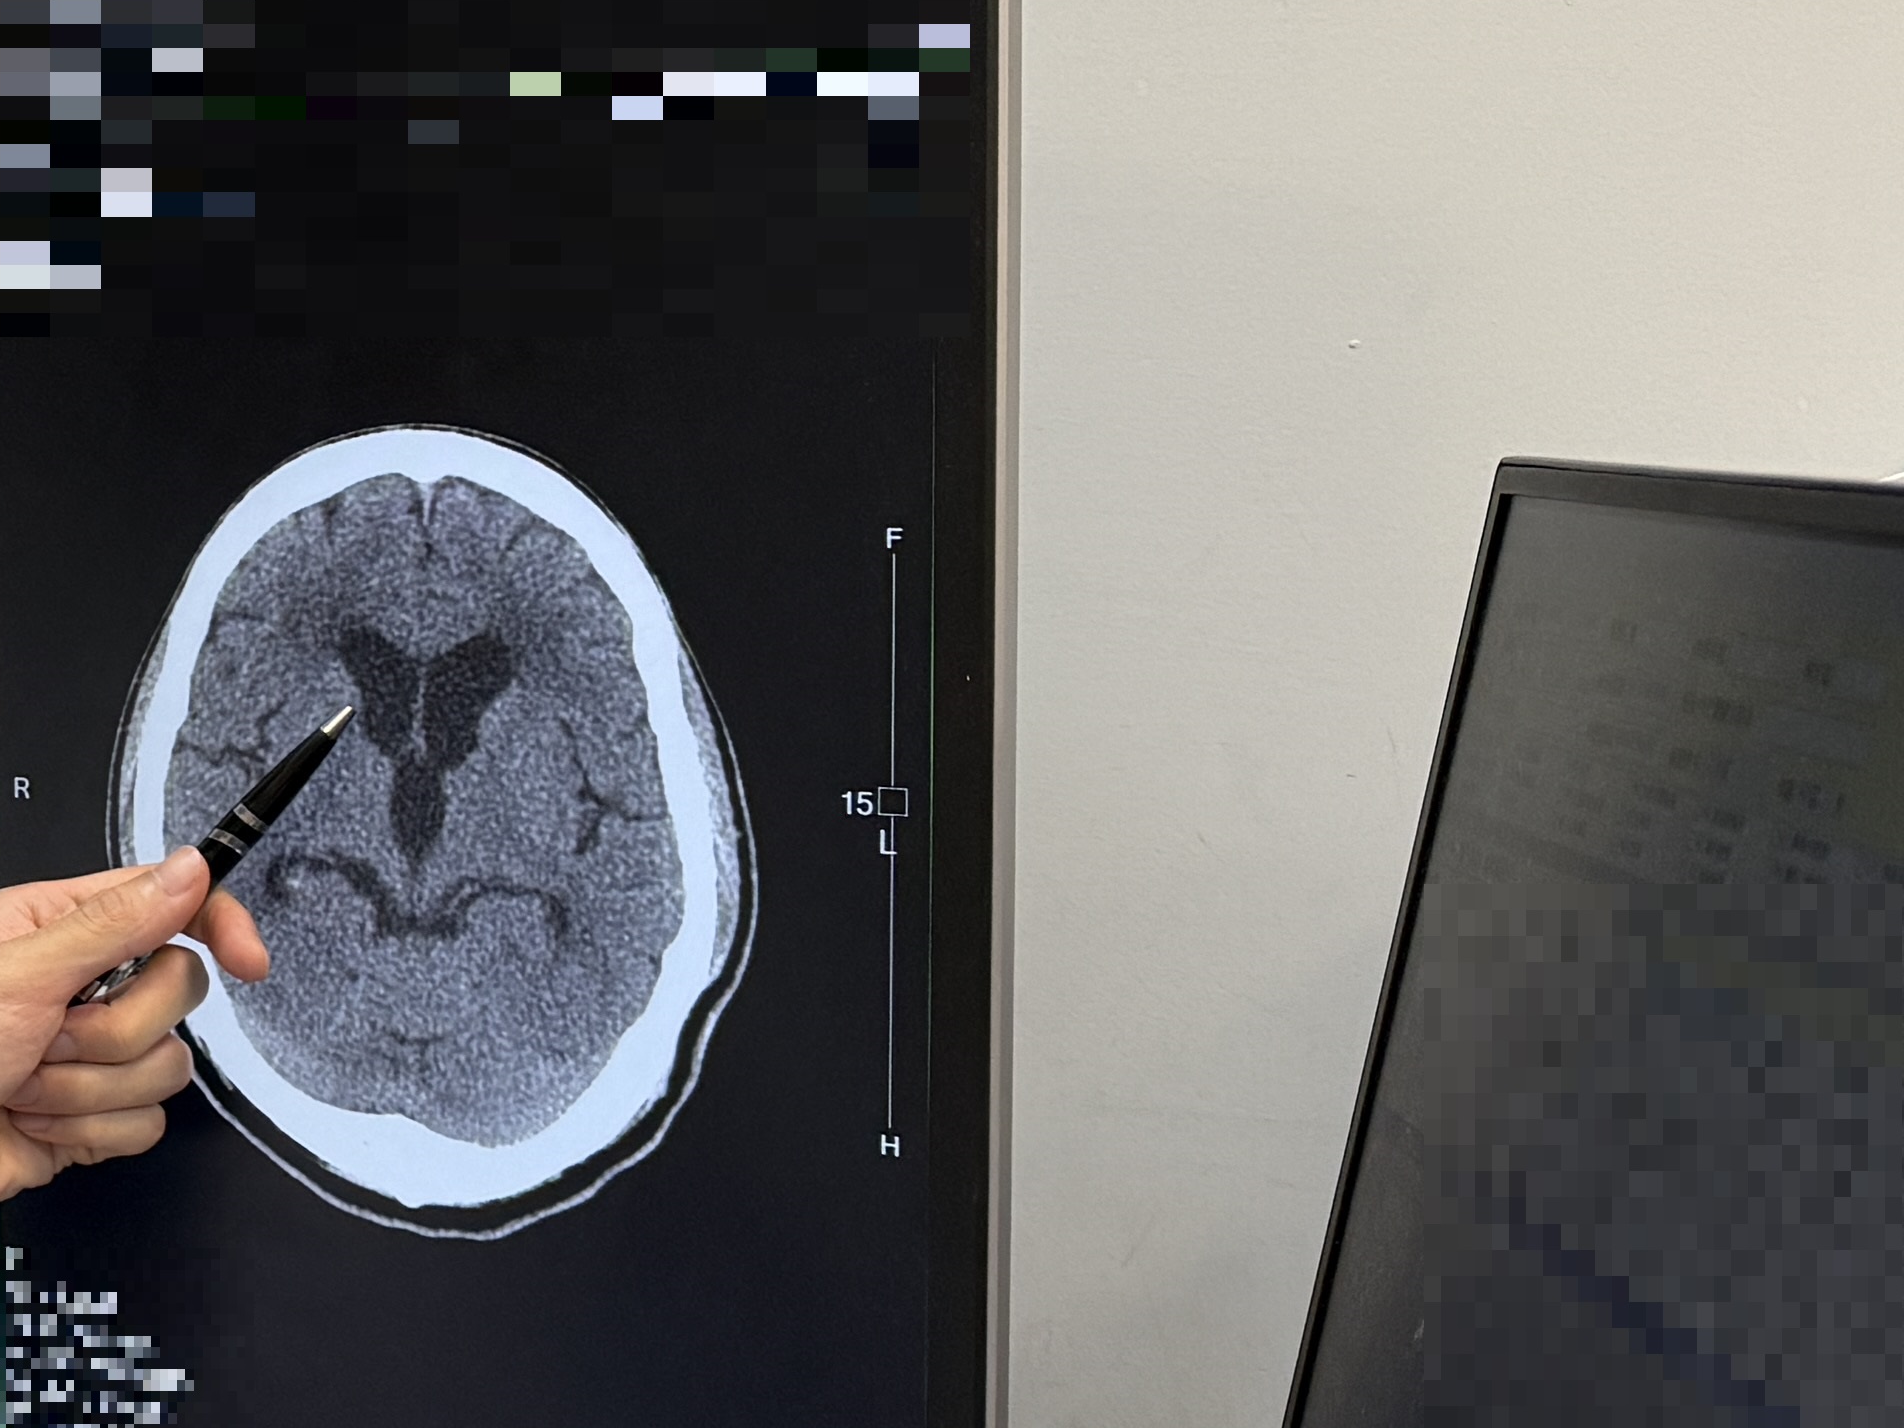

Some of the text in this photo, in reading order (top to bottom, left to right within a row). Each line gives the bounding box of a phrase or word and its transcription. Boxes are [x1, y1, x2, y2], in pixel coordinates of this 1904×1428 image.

[886, 527, 904, 549] F
[13, 776, 30, 799] R
[841, 790, 874, 816] 15
[880, 1134, 900, 1158] H
